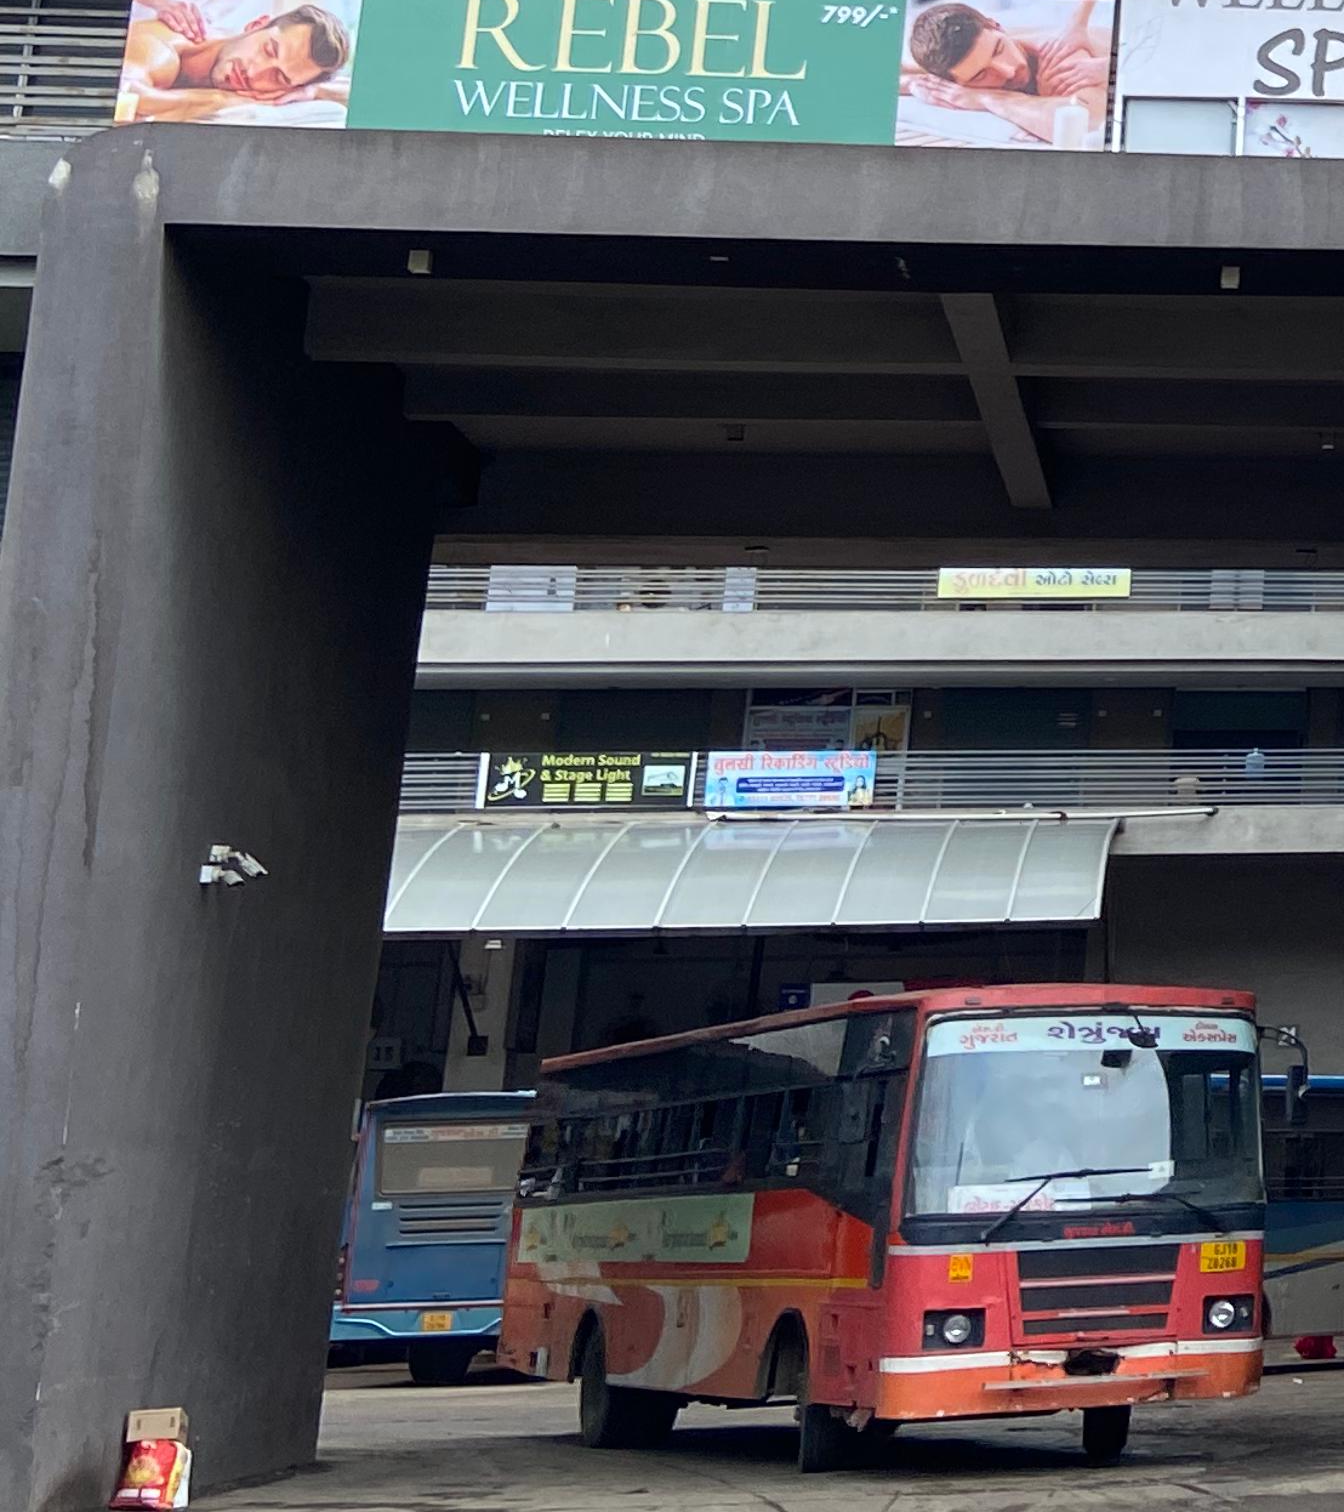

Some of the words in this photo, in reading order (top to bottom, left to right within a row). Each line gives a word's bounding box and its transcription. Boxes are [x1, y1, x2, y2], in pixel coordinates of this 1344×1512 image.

[454, 80, 706, 123] WELLNESS
[719, 87, 801, 127] SPA
[541, 754, 595, 767] Modern
[598, 753, 641, 767] Sound
[540, 769, 551, 781] &
[555, 769, 594, 784] Stage
[596, 769, 632, 784] Light
